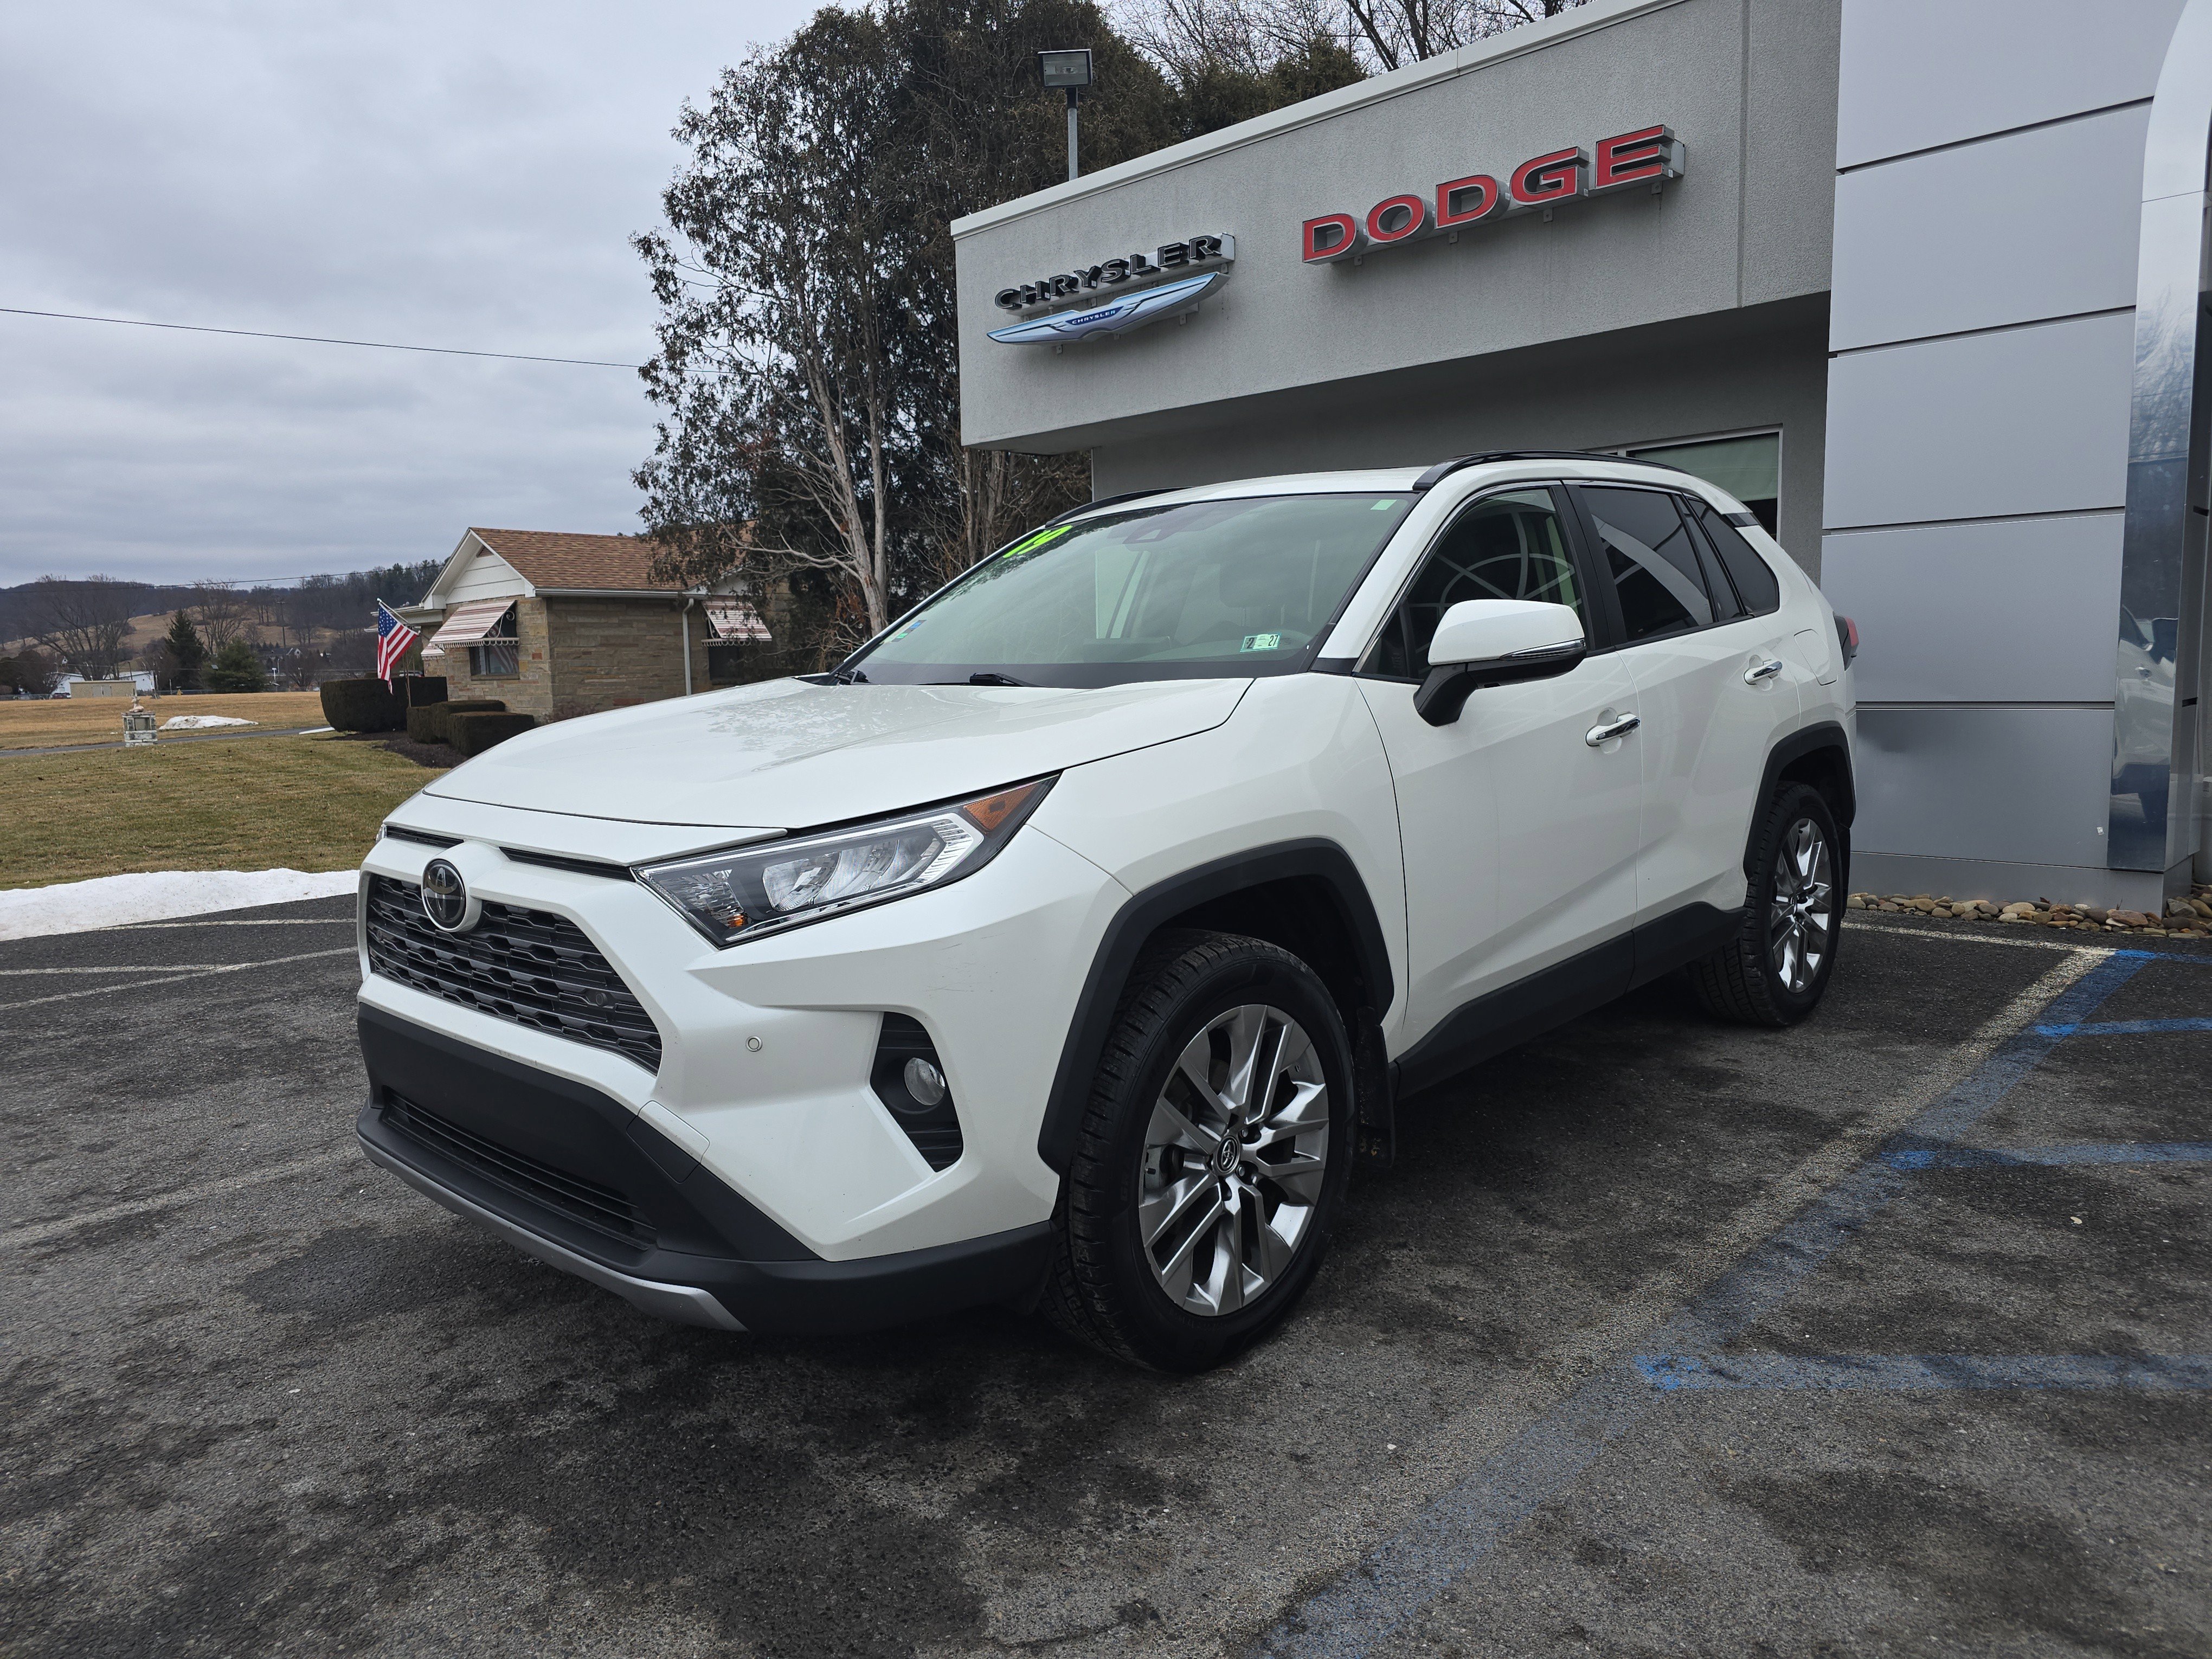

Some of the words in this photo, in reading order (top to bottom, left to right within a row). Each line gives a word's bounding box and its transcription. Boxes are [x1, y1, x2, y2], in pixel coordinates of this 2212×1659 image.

[1302, 124, 1670, 263] DODGE
[994, 235, 1223, 310] CHRYSLER
[1072, 310, 1116, 325] CHRYSLER
[1268, 635, 1279, 647] 27
